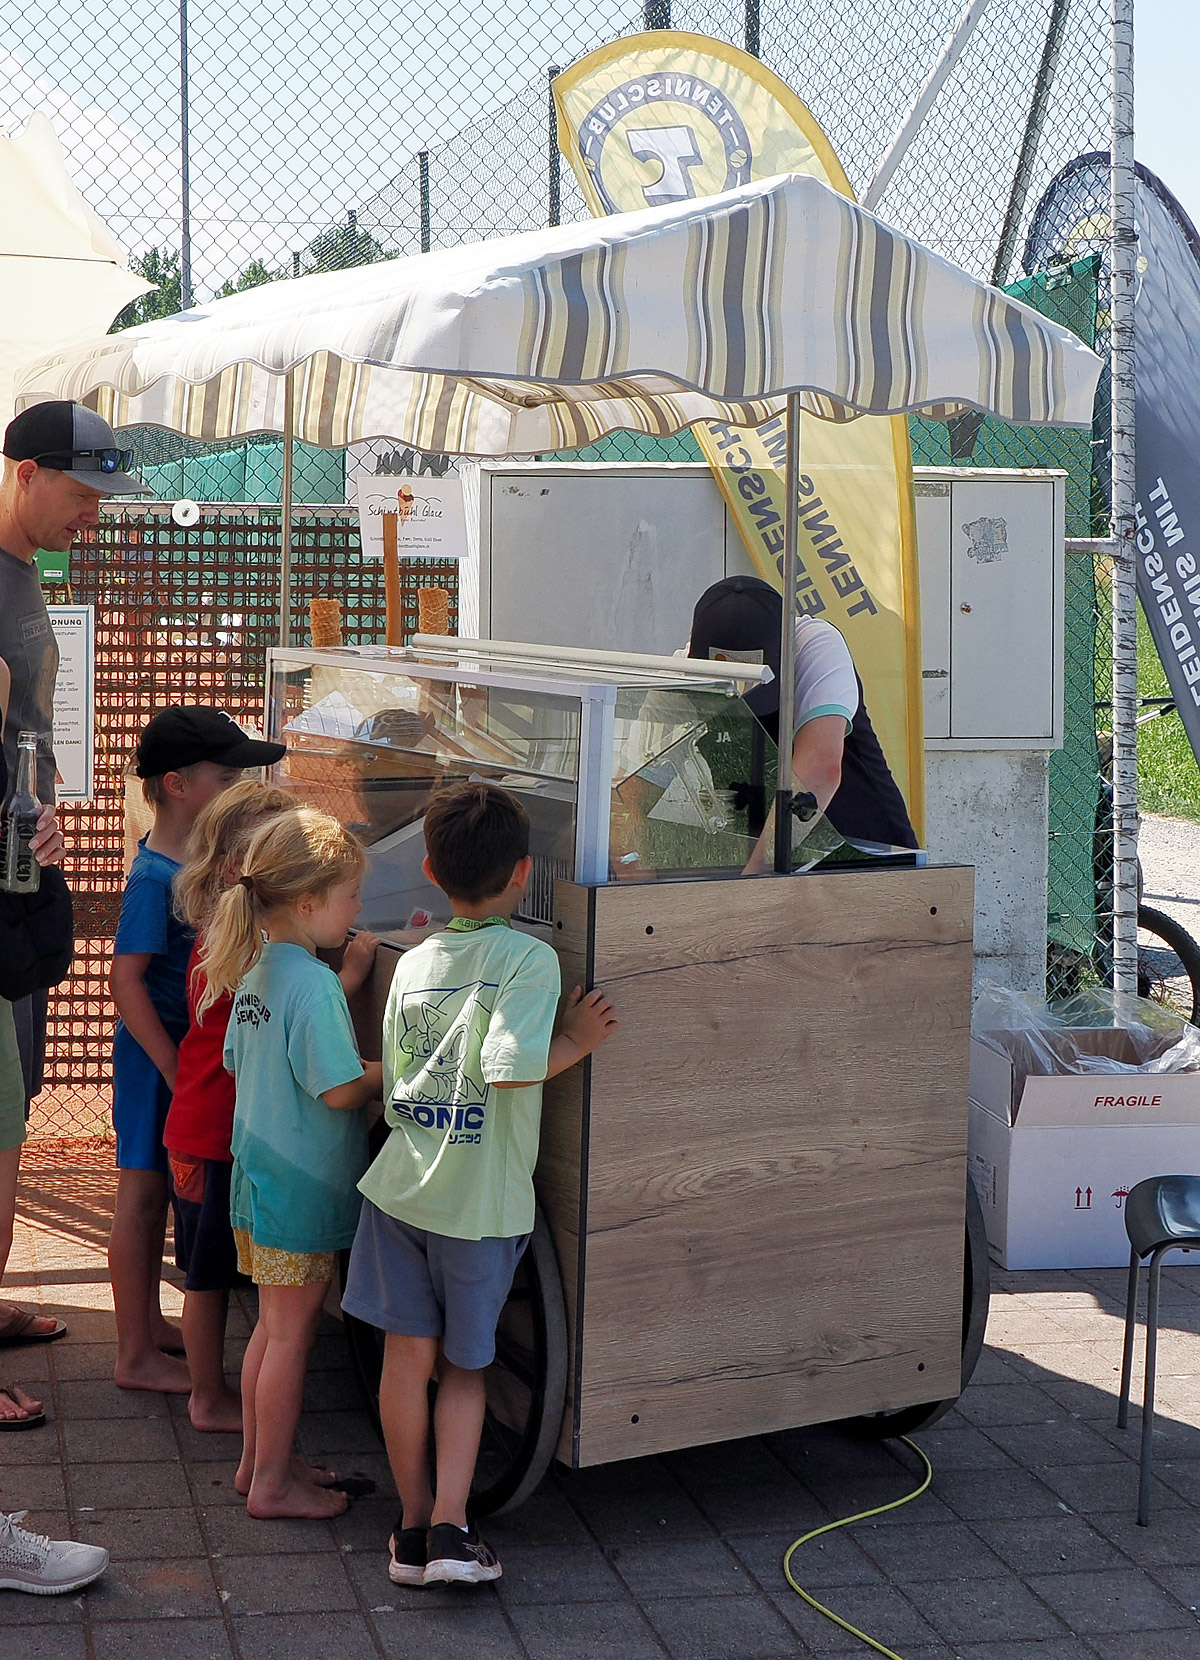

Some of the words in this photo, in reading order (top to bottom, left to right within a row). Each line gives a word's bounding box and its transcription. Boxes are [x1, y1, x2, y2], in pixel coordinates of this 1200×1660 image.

[422, 505, 443, 518] Glace
[1094, 1095, 1162, 1107] FRAGILE
[392, 1103, 485, 1131] SONIC
